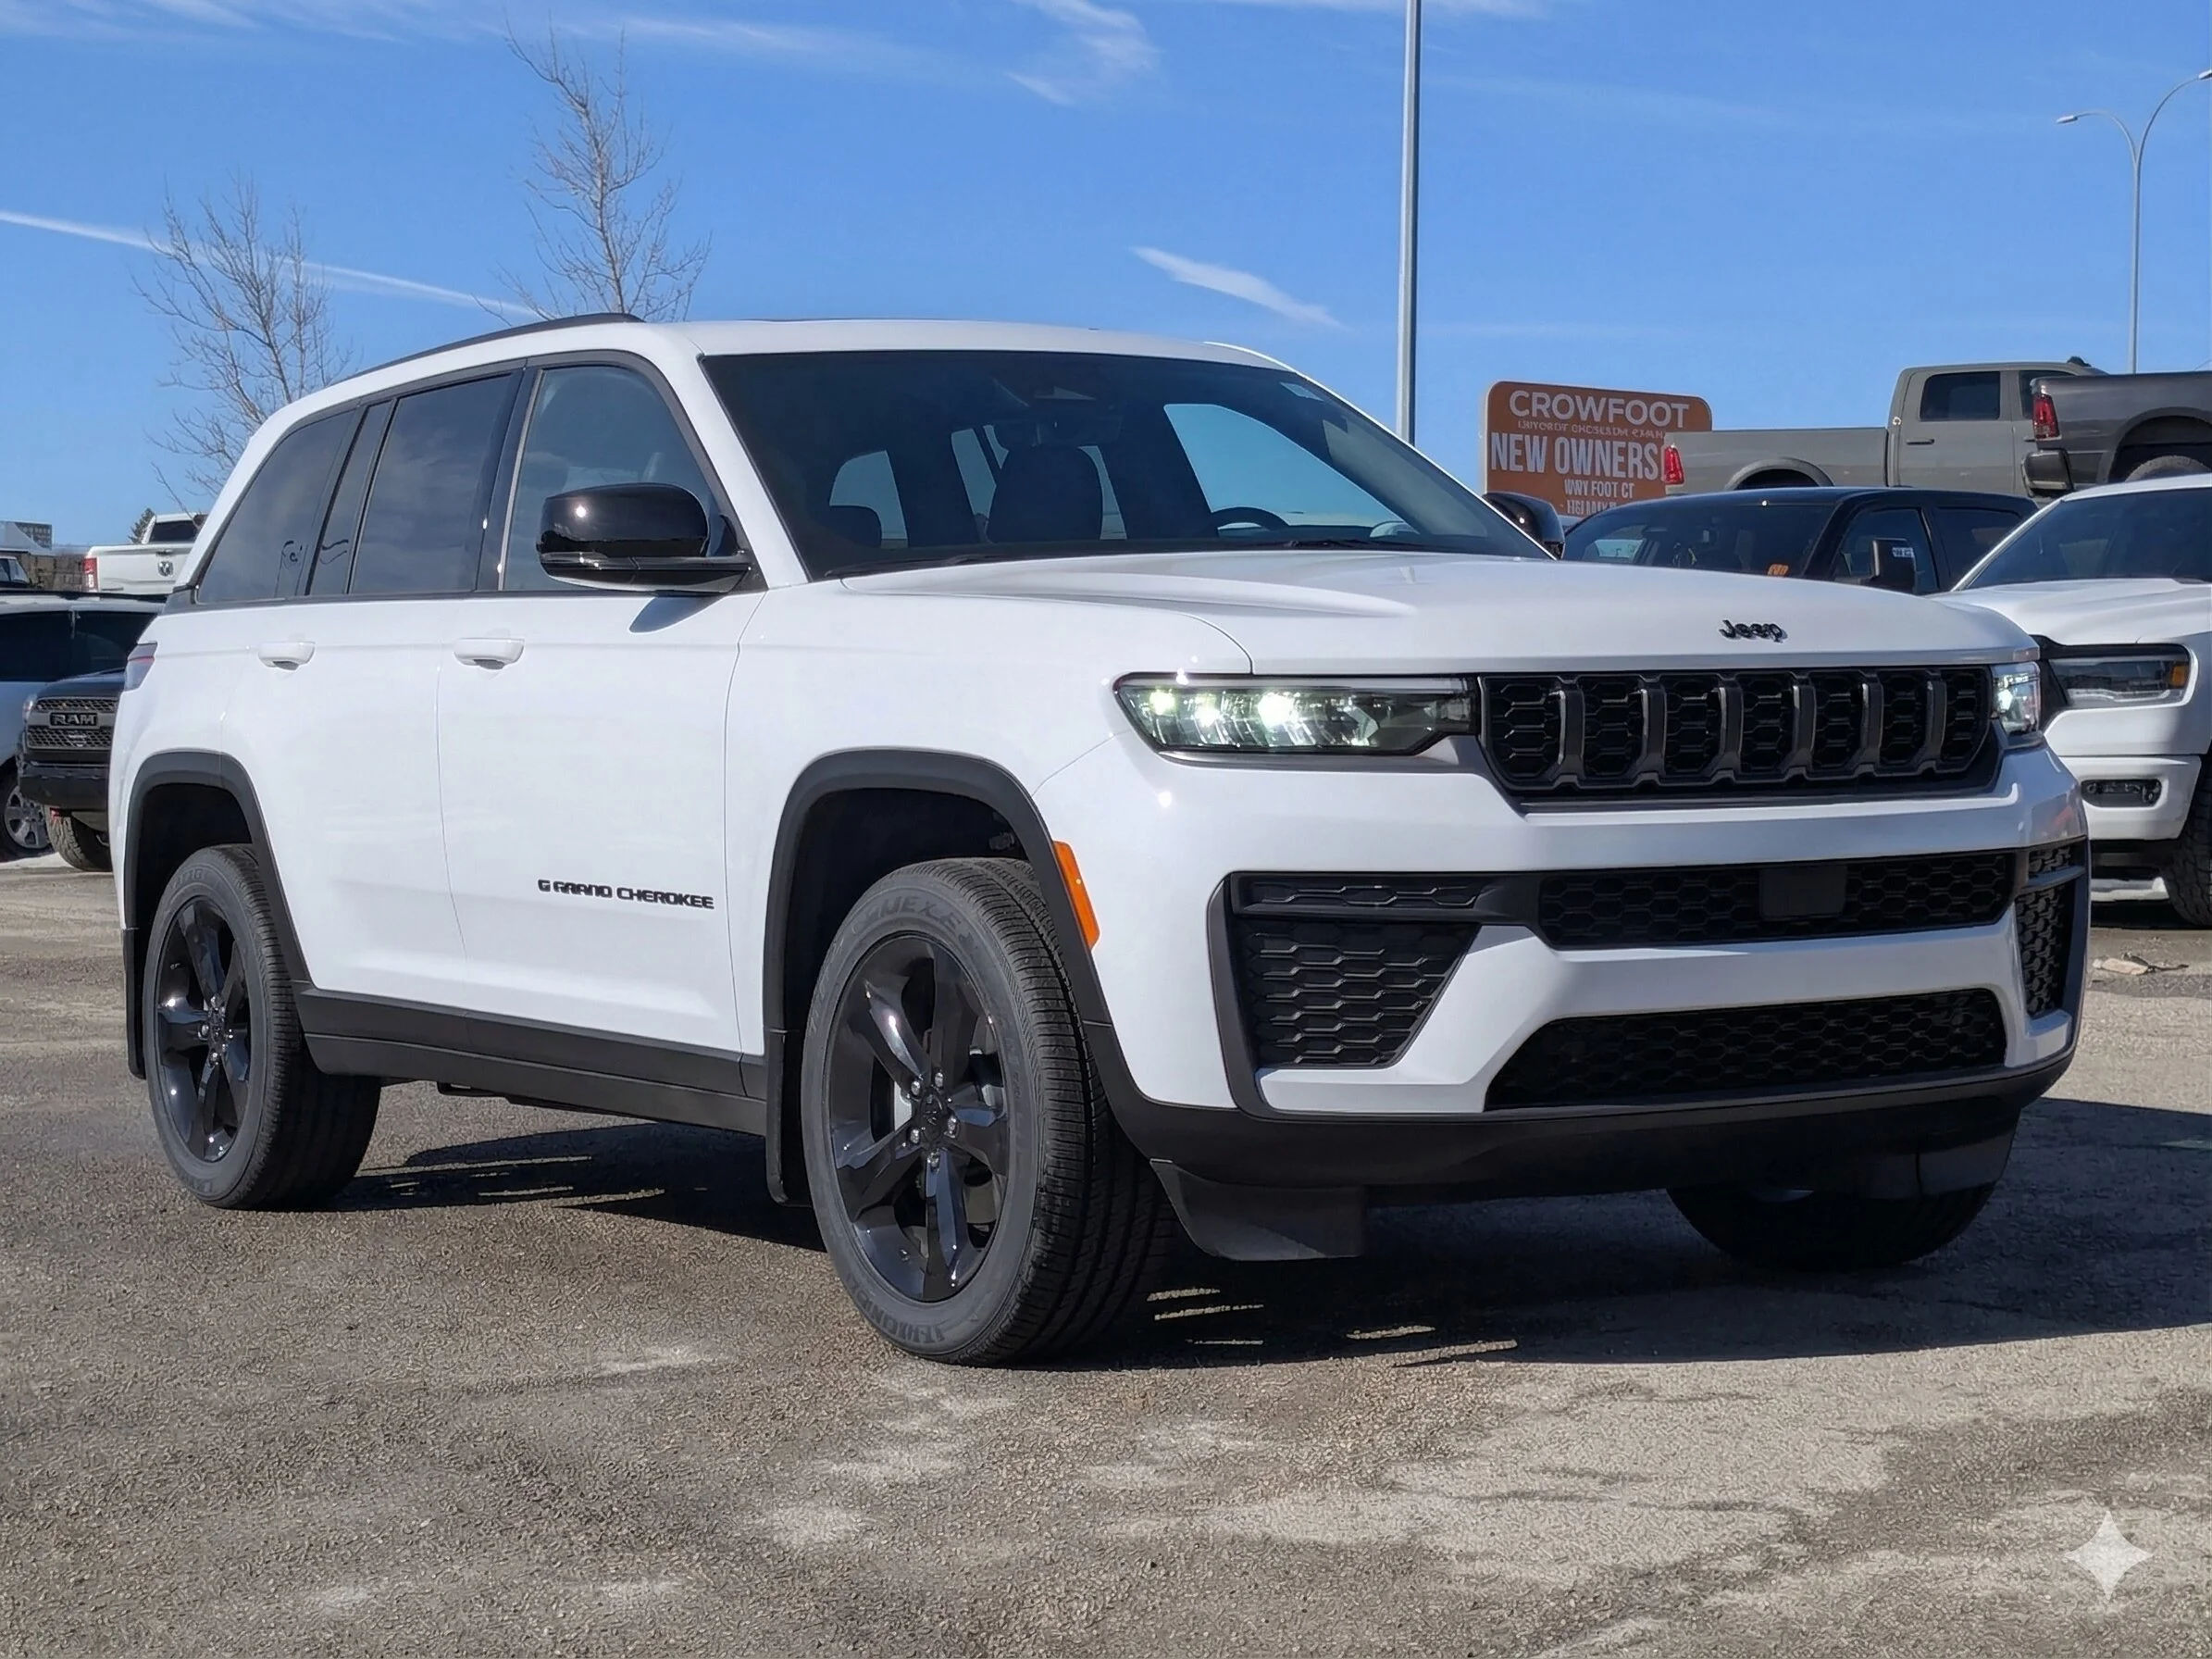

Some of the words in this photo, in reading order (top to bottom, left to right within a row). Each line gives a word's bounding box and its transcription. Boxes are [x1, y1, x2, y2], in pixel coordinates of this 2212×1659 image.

[1509, 390, 1689, 428] CROWFOOT
[1490, 431, 1547, 473] NEW
[1554, 436, 1659, 481] OWNERS
[1591, 480, 1619, 498] FOOT
[1621, 482, 1634, 499] CT
[1719, 619, 1787, 643] Jeep
[53, 714, 95, 725] RAM
[616, 887, 715, 909] CHEROKEE
